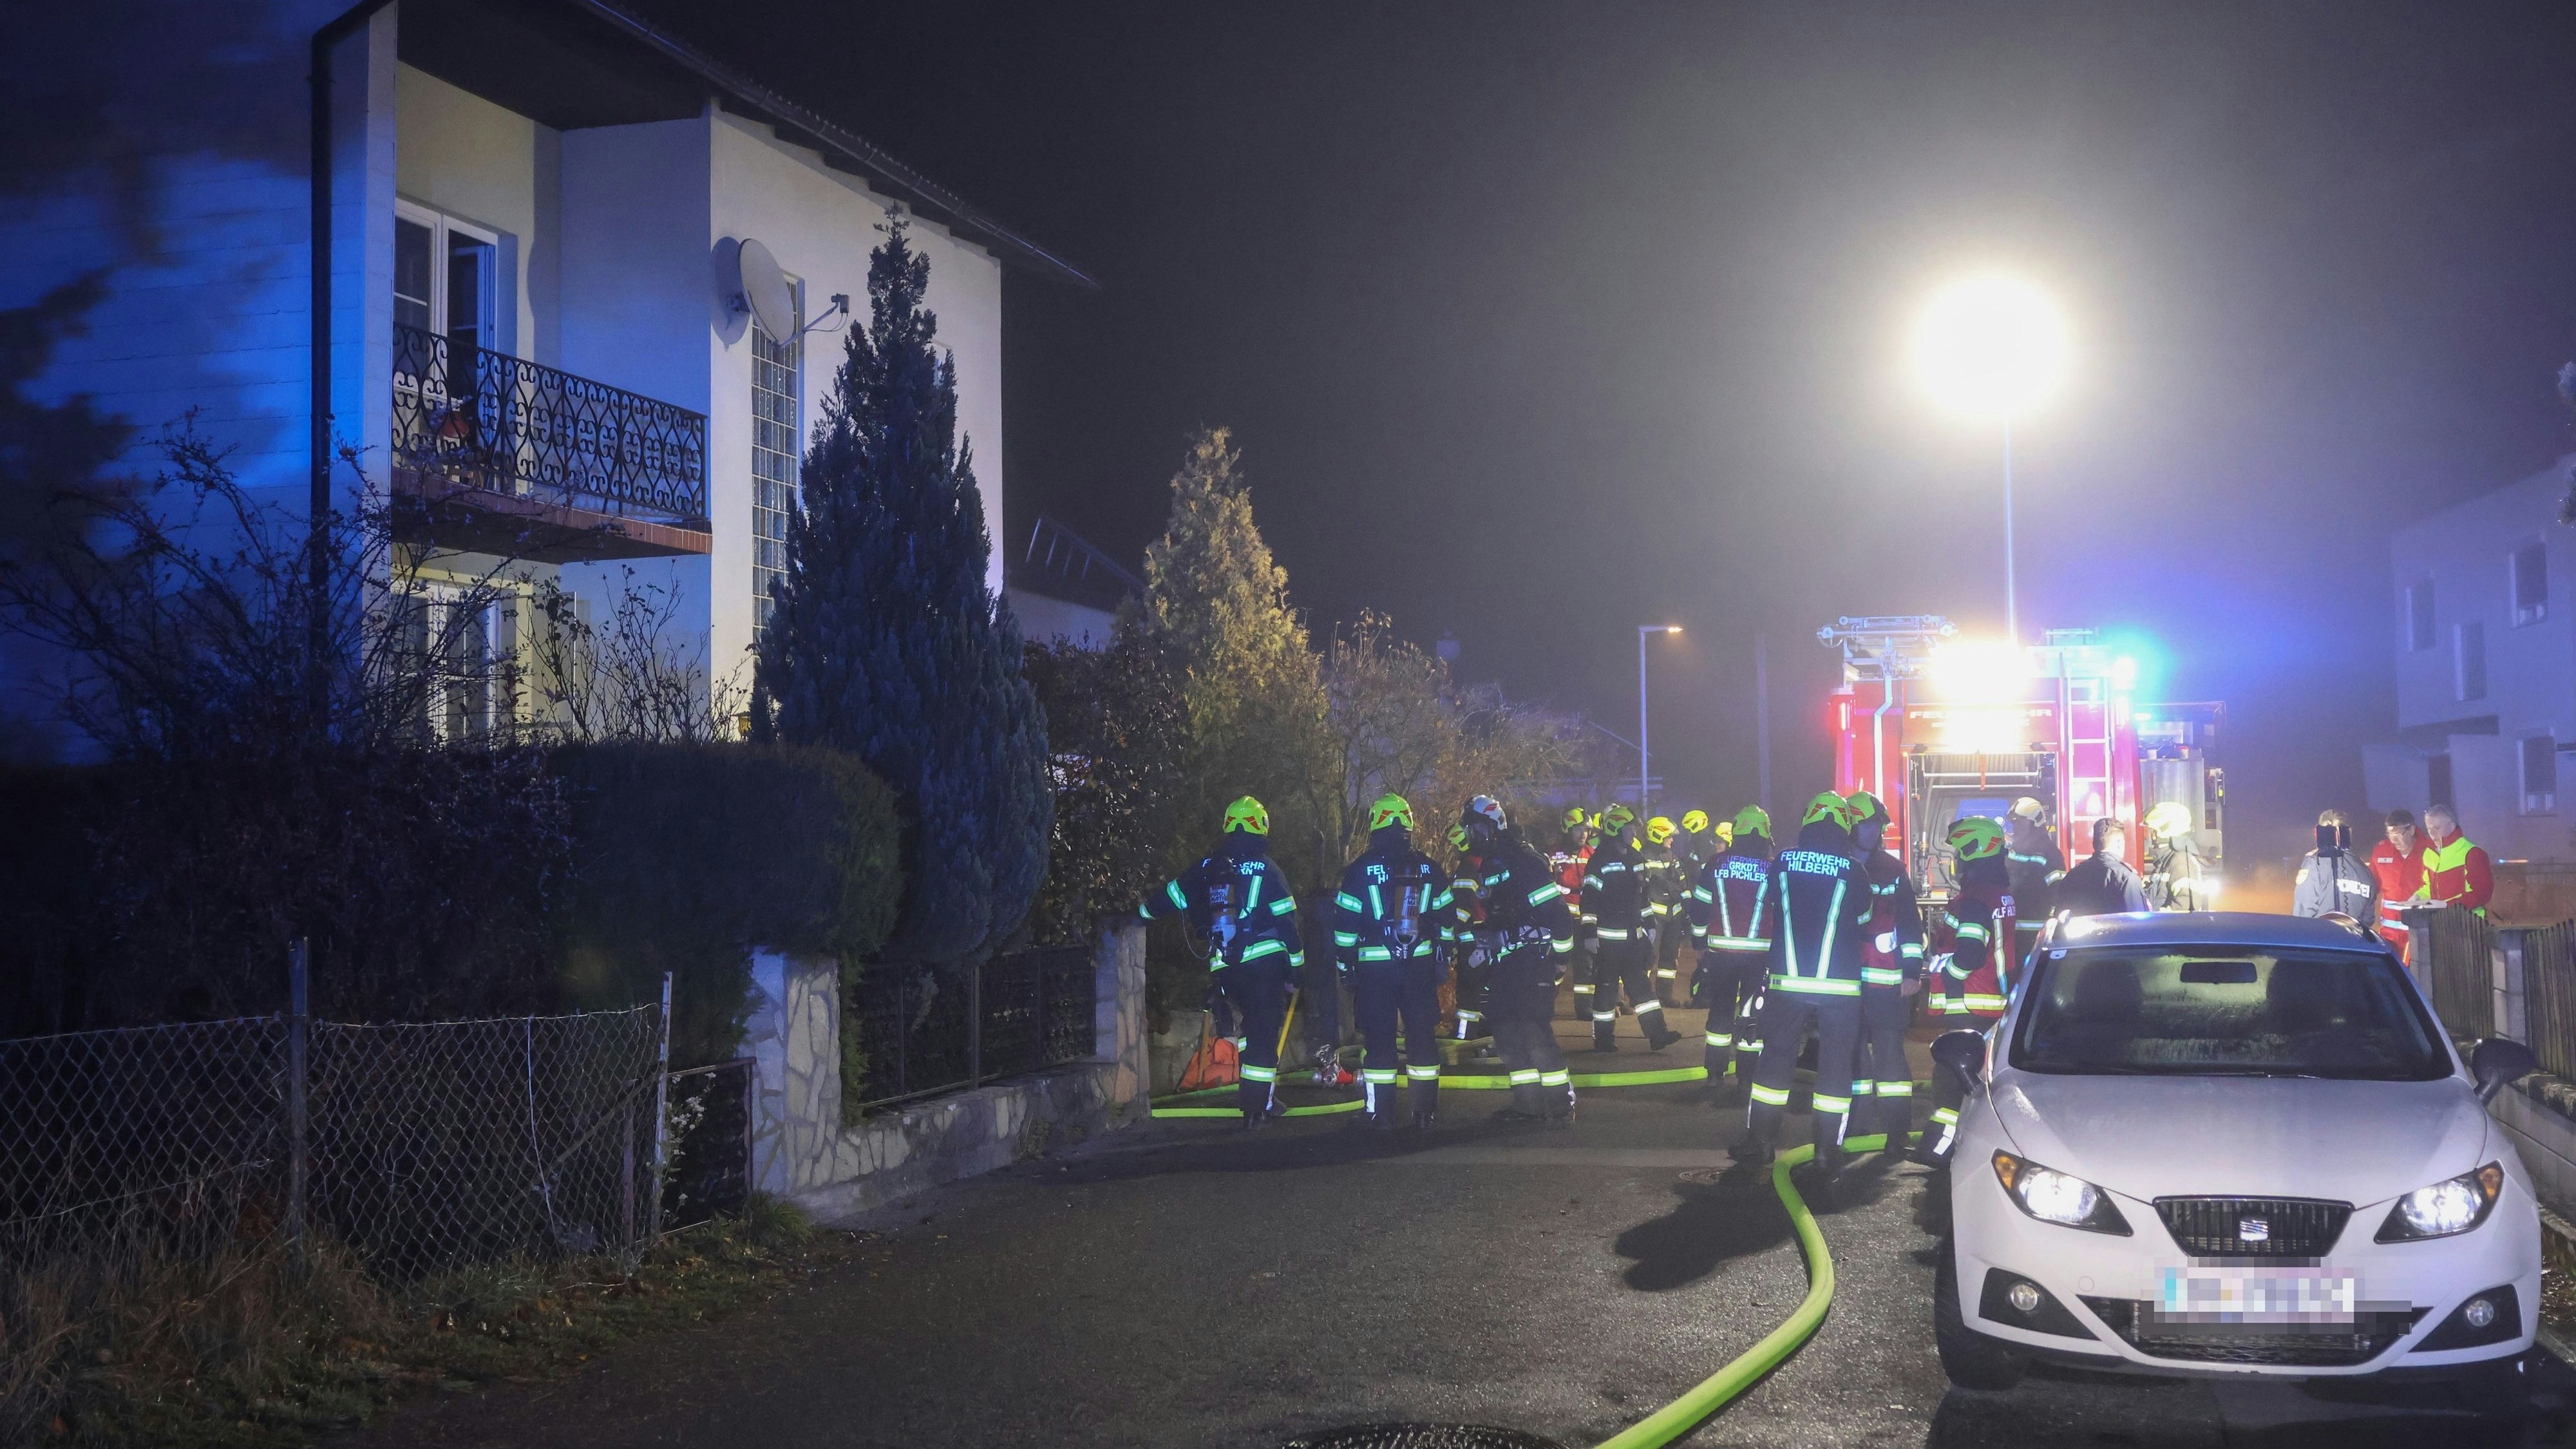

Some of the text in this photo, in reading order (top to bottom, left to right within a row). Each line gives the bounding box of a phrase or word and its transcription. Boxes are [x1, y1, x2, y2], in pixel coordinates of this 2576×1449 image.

[1729, 861, 1758, 873] GRKDT
[1781, 851, 1850, 870] FEUERWEHR
[1714, 869, 1729, 878] LFB
[1730, 869, 1768, 883] PICHLER
[1788, 860, 1839, 877] HILBERN
